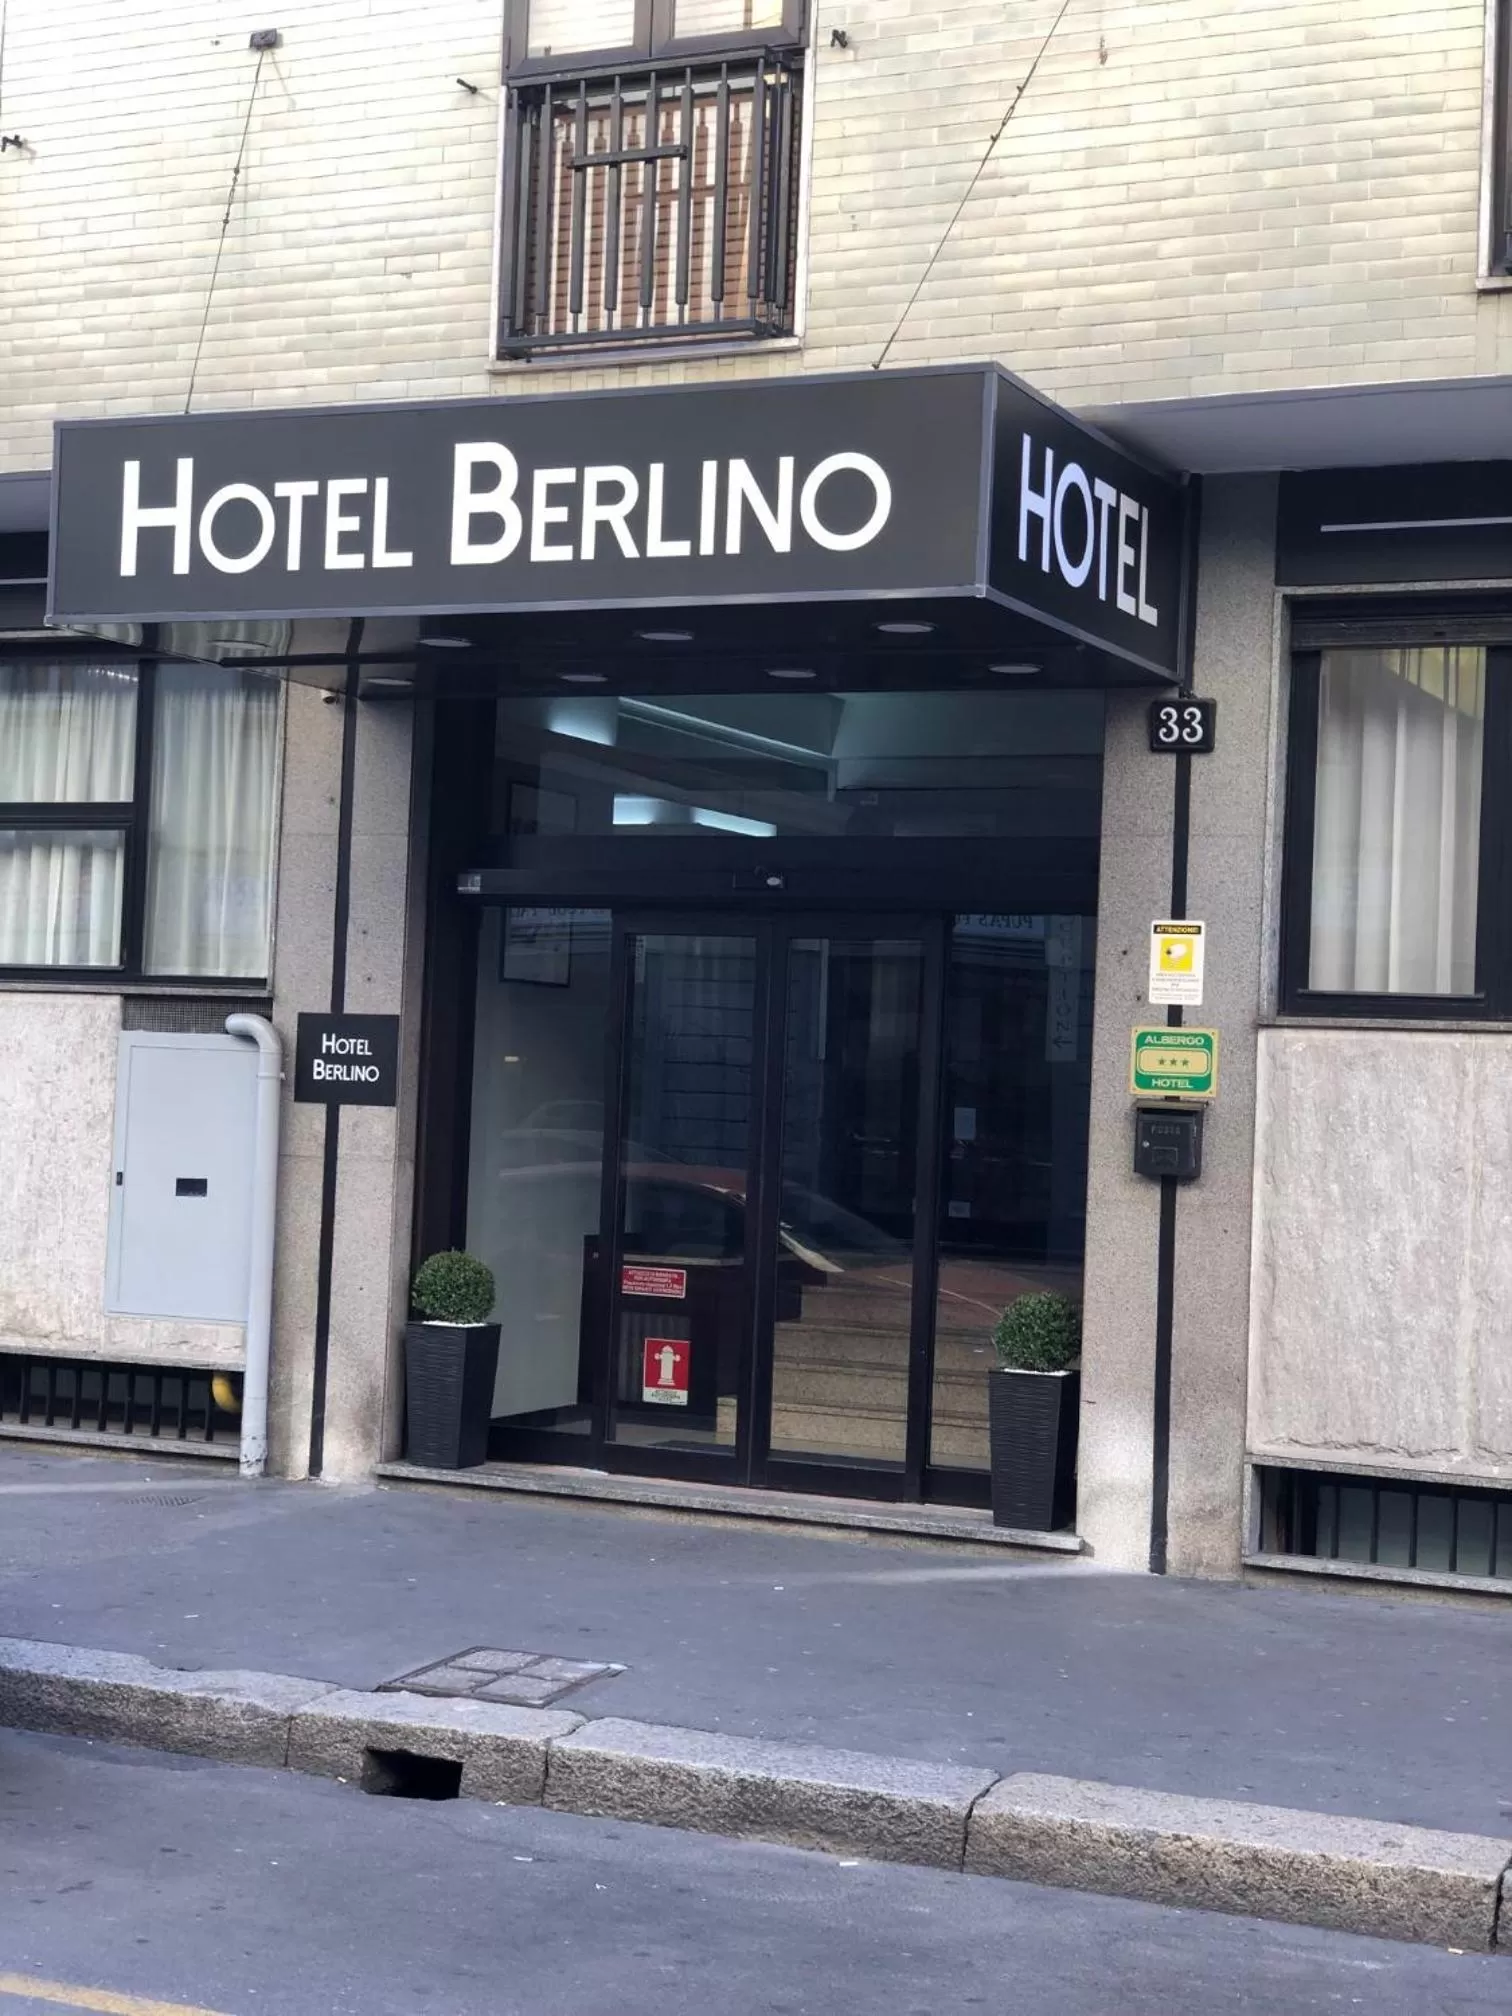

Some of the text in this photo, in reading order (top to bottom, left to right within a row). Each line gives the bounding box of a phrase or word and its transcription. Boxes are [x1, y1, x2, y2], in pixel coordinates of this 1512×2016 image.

[120, 441, 892, 577] HOTEL BERLINO
[1018, 433, 1158, 627] HOTEL
[1158, 706, 1205, 743] 33
[321, 1033, 373, 1055] HOTEL
[1143, 1034, 1205, 1046] ALBERGO
[312, 1058, 380, 1083] BERLINO
[1151, 1077, 1195, 1088] HOTEL
